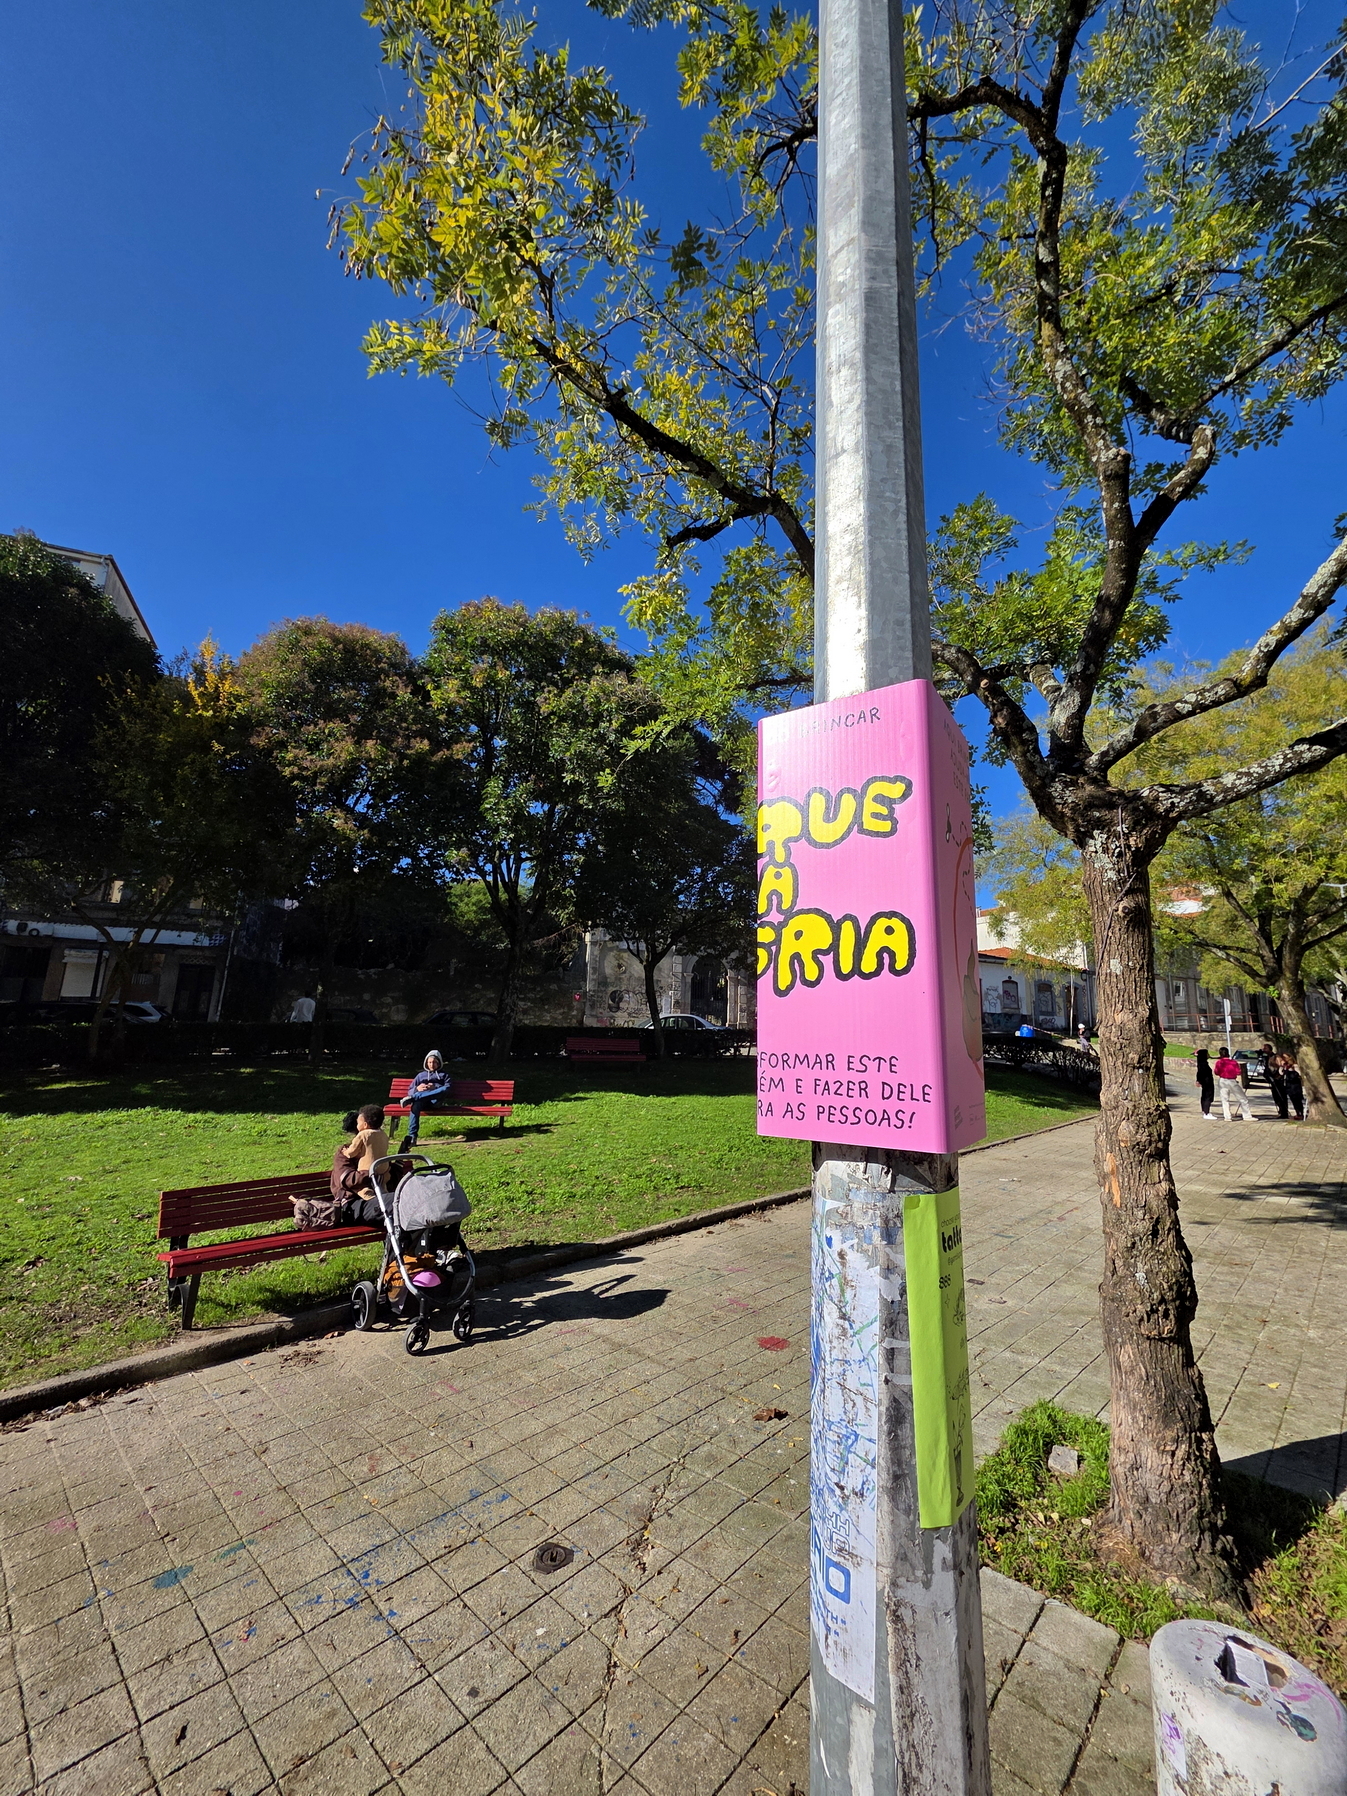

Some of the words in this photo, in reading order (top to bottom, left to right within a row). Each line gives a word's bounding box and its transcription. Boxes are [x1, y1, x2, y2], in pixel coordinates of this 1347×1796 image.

[757, 1051, 836, 1072] FORMAR
[847, 1054, 899, 1074] ESTE
[795, 1078, 803, 1095] E
[813, 1078, 870, 1099] FAZER
[881, 1081, 933, 1103] DELE
[782, 1102, 807, 1121] AS
[816, 1104, 916, 1130] PESSOAS!
